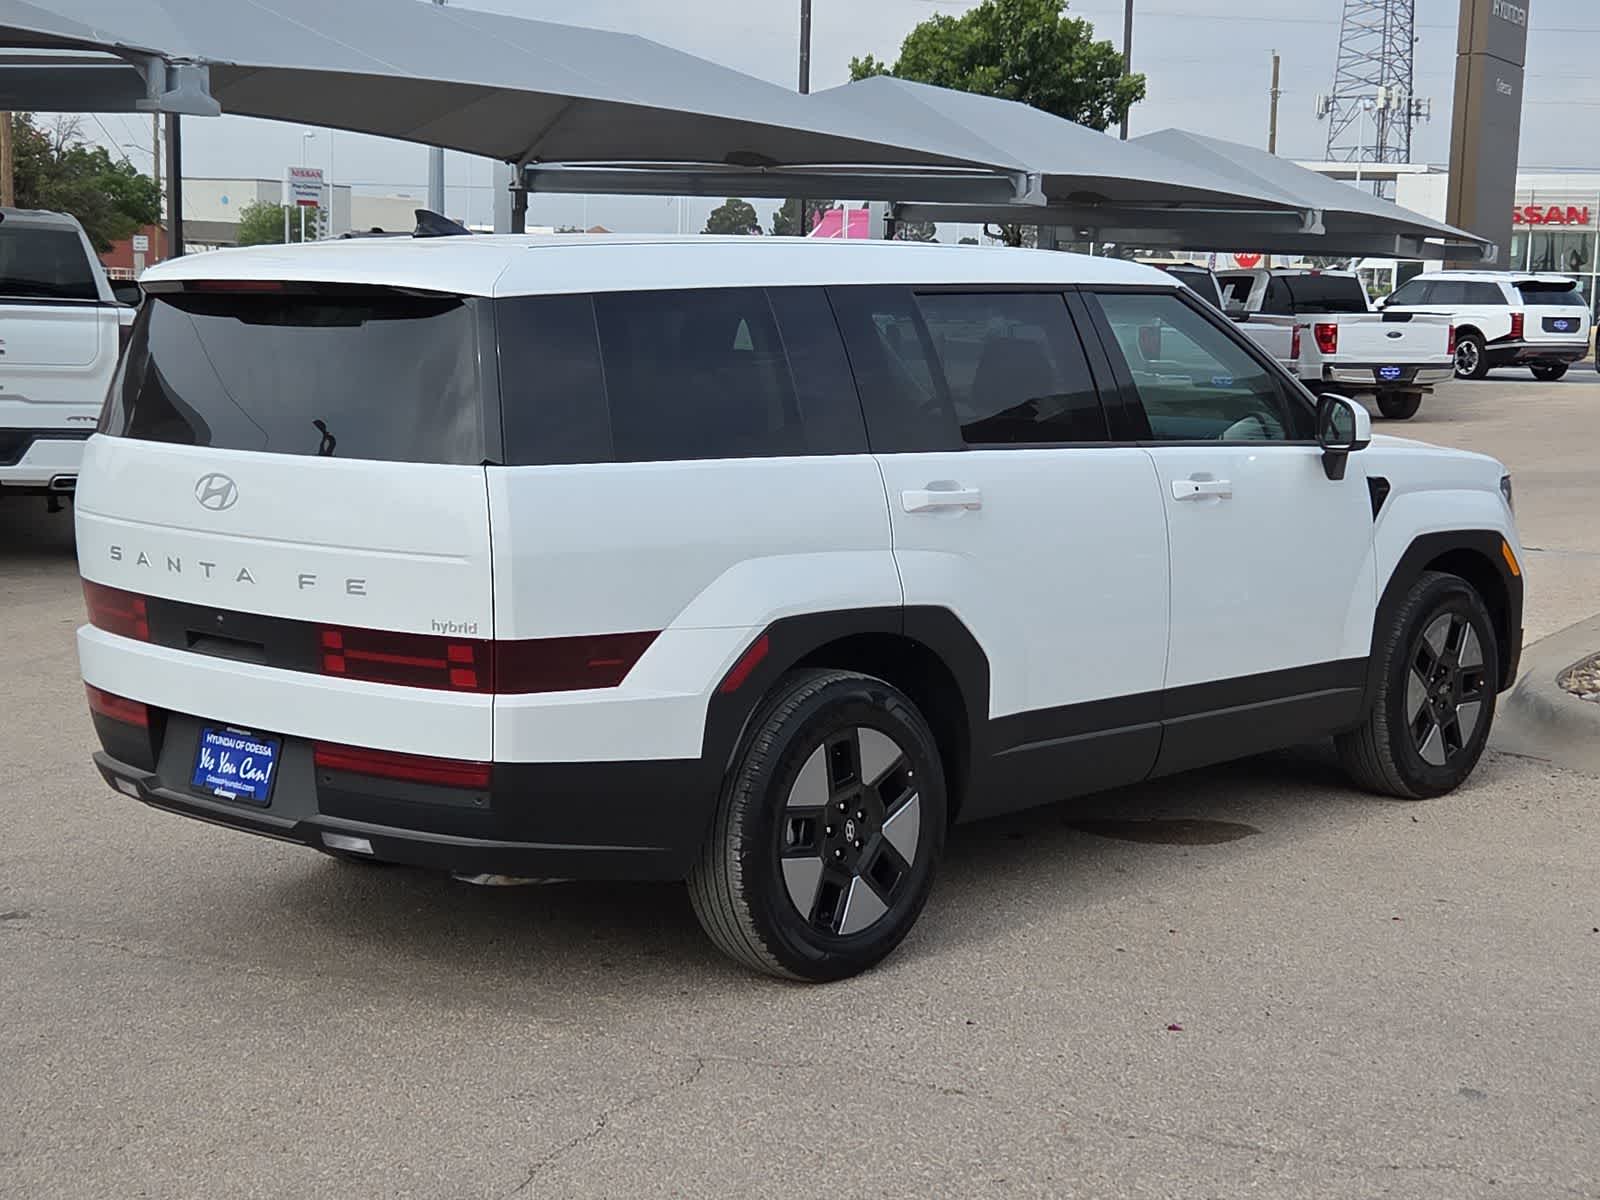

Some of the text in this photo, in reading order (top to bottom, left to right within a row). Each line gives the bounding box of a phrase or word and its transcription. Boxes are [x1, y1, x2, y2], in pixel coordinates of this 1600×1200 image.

[109, 545, 367, 596] SANTA FE
[431, 618, 478, 634] hybrid
[206, 734, 272, 756] HYUNDAI OF ODESSA
[199, 747, 273, 784] Yes You Can!
